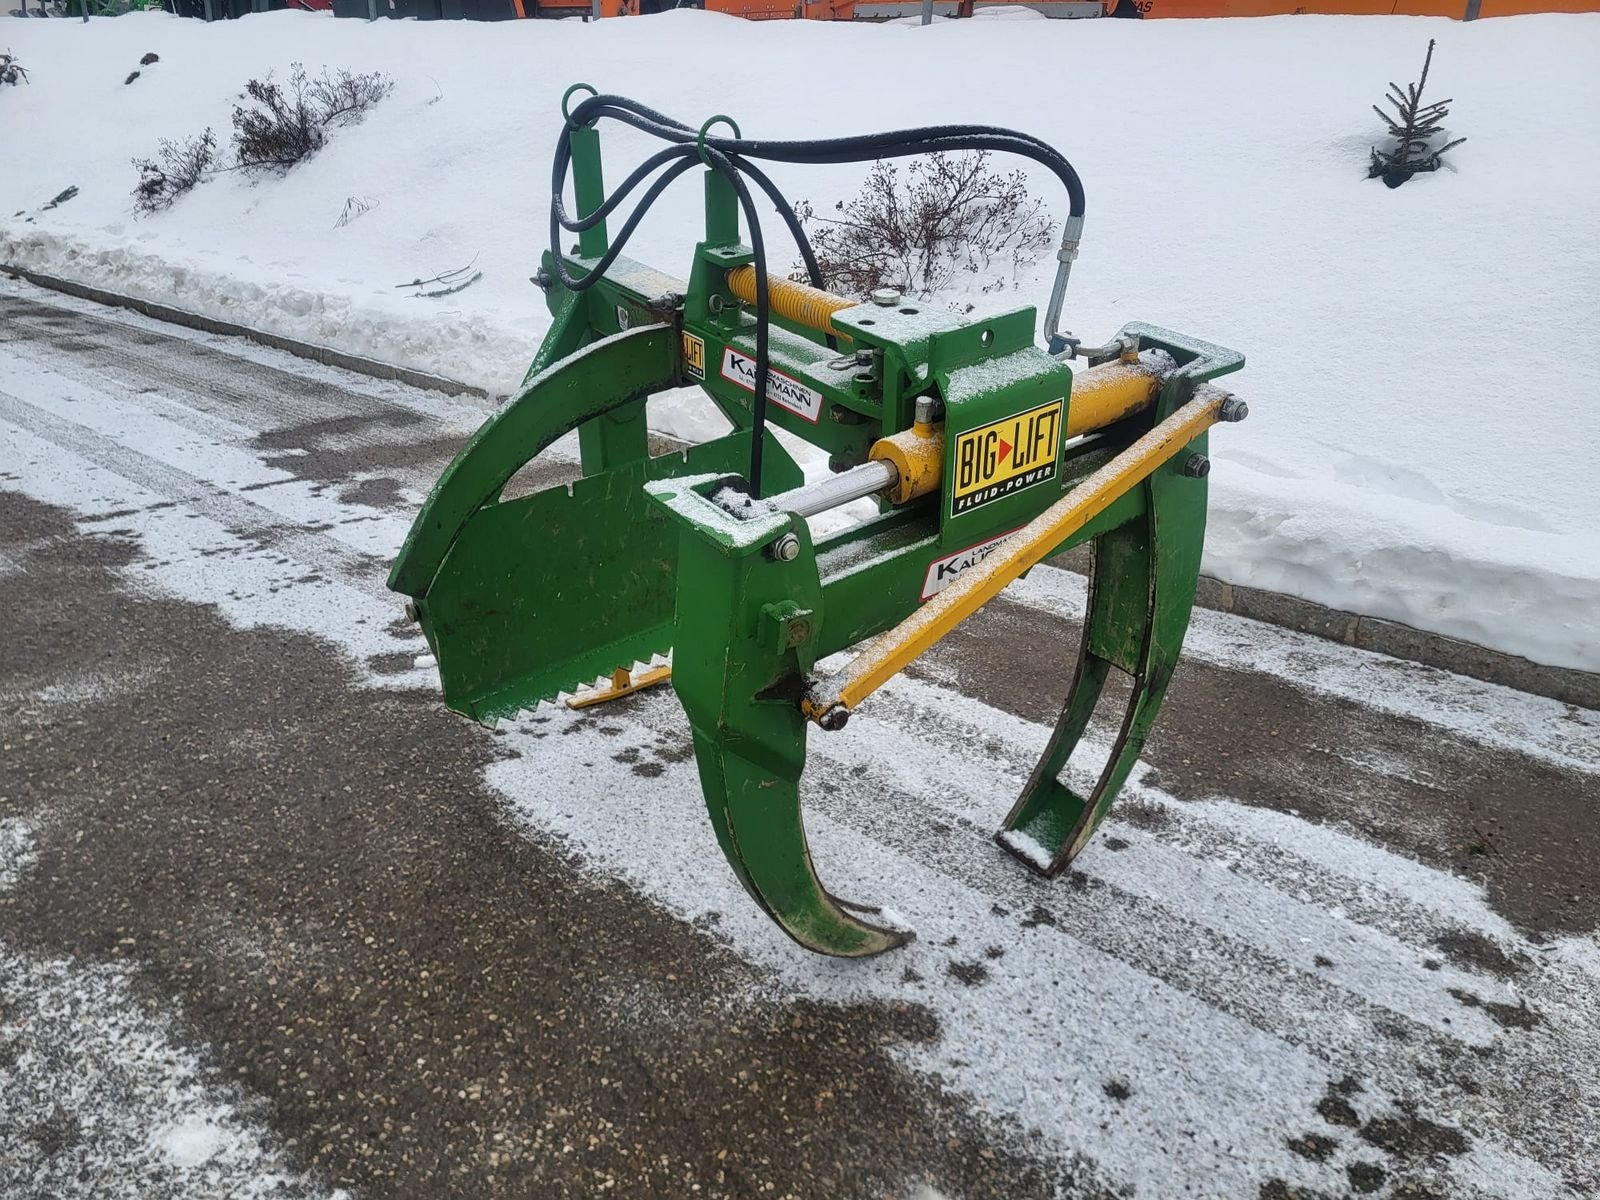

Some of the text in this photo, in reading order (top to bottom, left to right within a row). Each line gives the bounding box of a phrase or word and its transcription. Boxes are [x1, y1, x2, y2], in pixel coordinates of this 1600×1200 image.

[960, 408, 1059, 489] BIG LIFT
[958, 466, 1051, 510] FLUID-POWER
